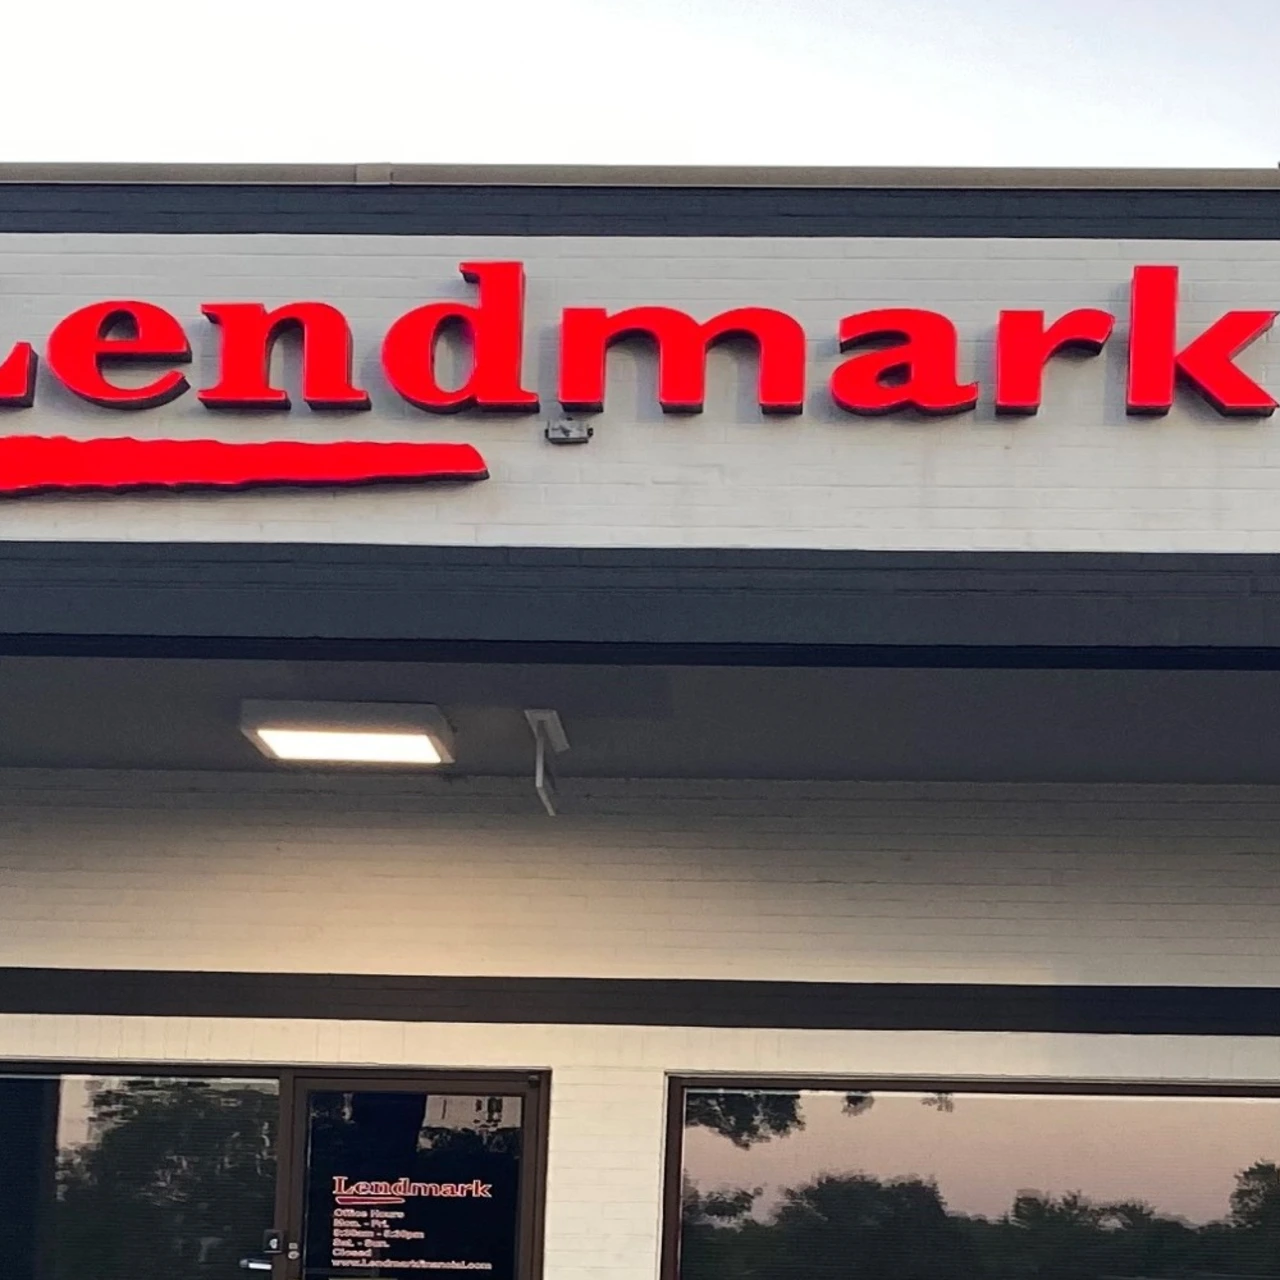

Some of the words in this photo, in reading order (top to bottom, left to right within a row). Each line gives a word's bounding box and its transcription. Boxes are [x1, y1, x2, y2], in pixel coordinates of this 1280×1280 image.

[332, 1175, 493, 1198] Lendmark
[333, 1208, 368, 1217] Office
[370, 1209, 405, 1218] Hours
[332, 1248, 372, 1257] Closed
